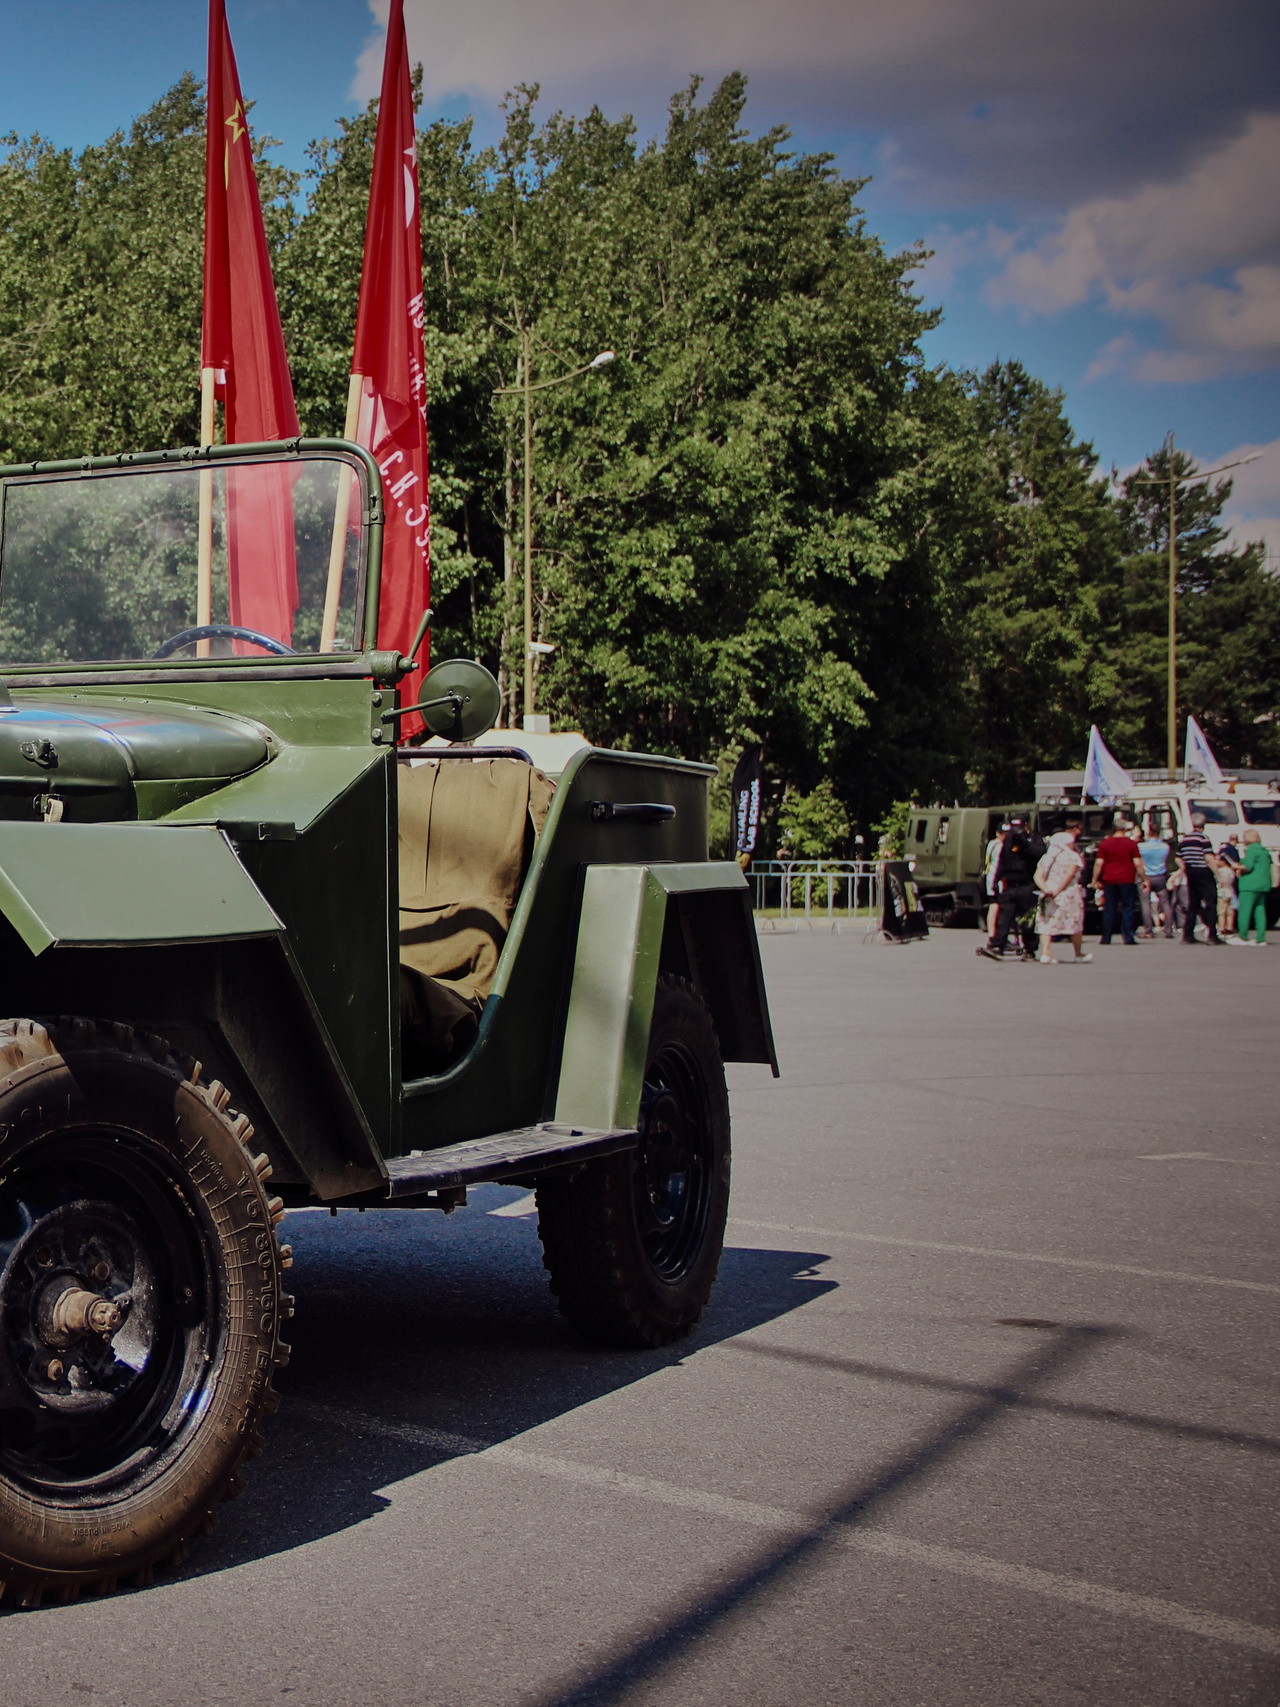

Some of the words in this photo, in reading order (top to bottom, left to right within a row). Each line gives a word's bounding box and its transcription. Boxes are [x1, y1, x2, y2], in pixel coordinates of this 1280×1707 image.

[749, 777, 760, 826] SCHOOL
[737, 789, 750, 849] DETAILING
[746, 825, 757, 850] LAB
[240, 1346, 251, 1370] TUBE
[233, 1374, 246, 1397] TYPE
[72, 1527, 100, 1537] RUSSIA
[100, 1525, 110, 1535] IN
[111, 1519, 132, 1532] MADE
